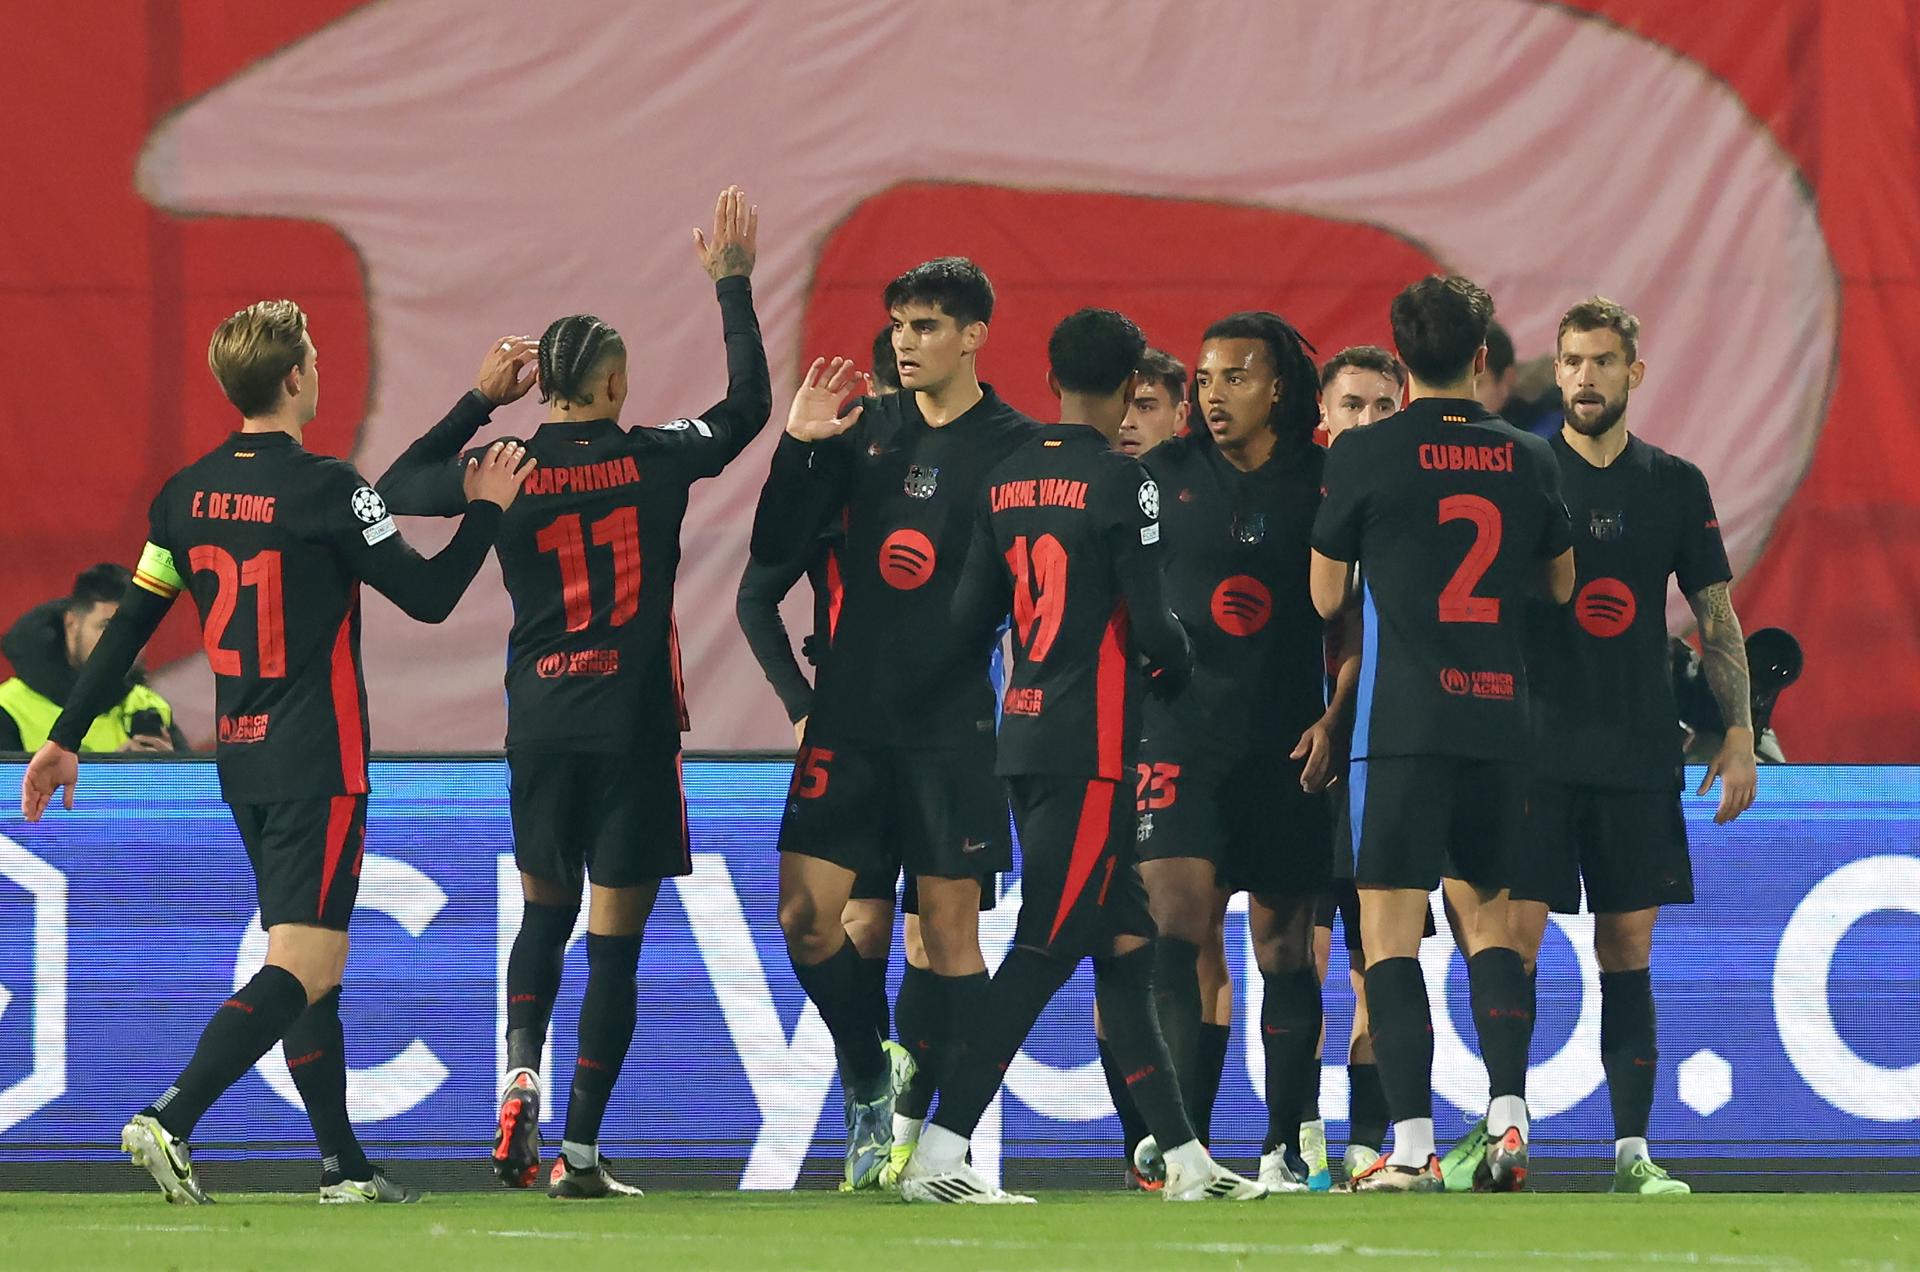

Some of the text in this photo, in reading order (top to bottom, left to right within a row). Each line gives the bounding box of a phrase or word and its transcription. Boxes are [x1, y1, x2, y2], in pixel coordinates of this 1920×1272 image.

[524, 455, 641, 496] RAPHINHA
[1418, 441, 1514, 472] CUBARSÍ
[208, 491, 232, 520] DE
[231, 493, 277, 524] JONG
[990, 478, 1089, 513] LAMINE YAMAL
[535, 505, 641, 634] 11
[1437, 494, 1501, 624] 2
[187, 544, 288, 678] 21
[1004, 533, 1068, 663] 19
[1136, 762, 1181, 811] 23
